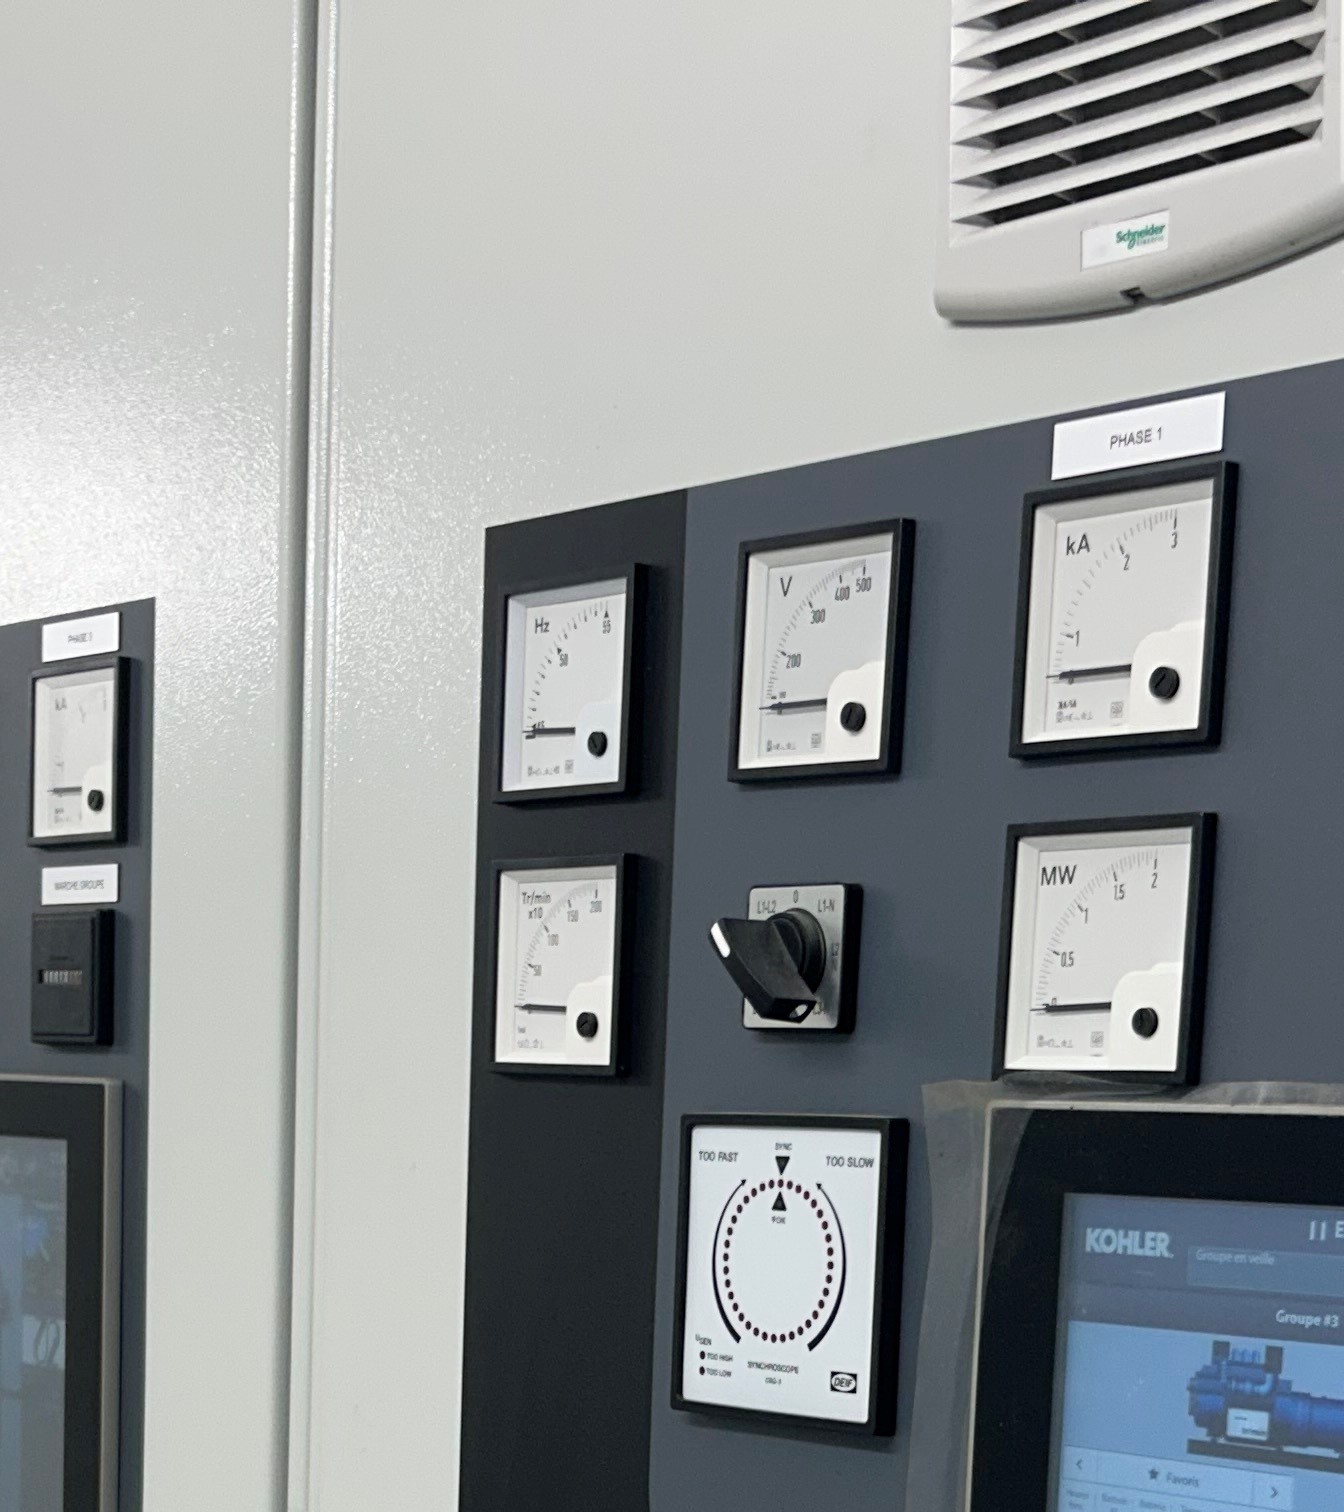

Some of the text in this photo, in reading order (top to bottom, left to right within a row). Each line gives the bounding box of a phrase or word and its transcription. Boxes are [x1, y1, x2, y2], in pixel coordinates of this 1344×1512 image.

[1115, 223, 1166, 250] Schneider
[1109, 426, 1163, 450] PHASE 1
[1065, 532, 1091, 557] kA
[1171, 531, 1179, 549] 3
[1123, 553, 1131, 571] 2
[779, 575, 793, 597] V
[855, 576, 872, 593] 500
[834, 585, 851, 602] 400
[810, 608, 826, 625] 300
[534, 617, 550, 634] Hz
[1075, 630, 1081, 647] 1
[786, 653, 802, 670] 200
[1040, 863, 1078, 887] MW
[1151, 872, 1158, 889] 2
[521, 888, 552, 906] Tr/min
[528, 906, 544, 920] x10
[1060, 950, 1075, 967] 0.5
[698, 1150, 739, 1163] TOO FAST
[825, 1155, 876, 1168] TOO SLOW
[1084, 1226, 1174, 1259] KOHLER
[1195, 1248, 1276, 1267] Groupe en veille
[1274, 1309, 1340, 1329] Groupe #3
[746, 1360, 800, 1375] SYNCHROSCOPE
[1166, 1472, 1200, 1489] Favoris
